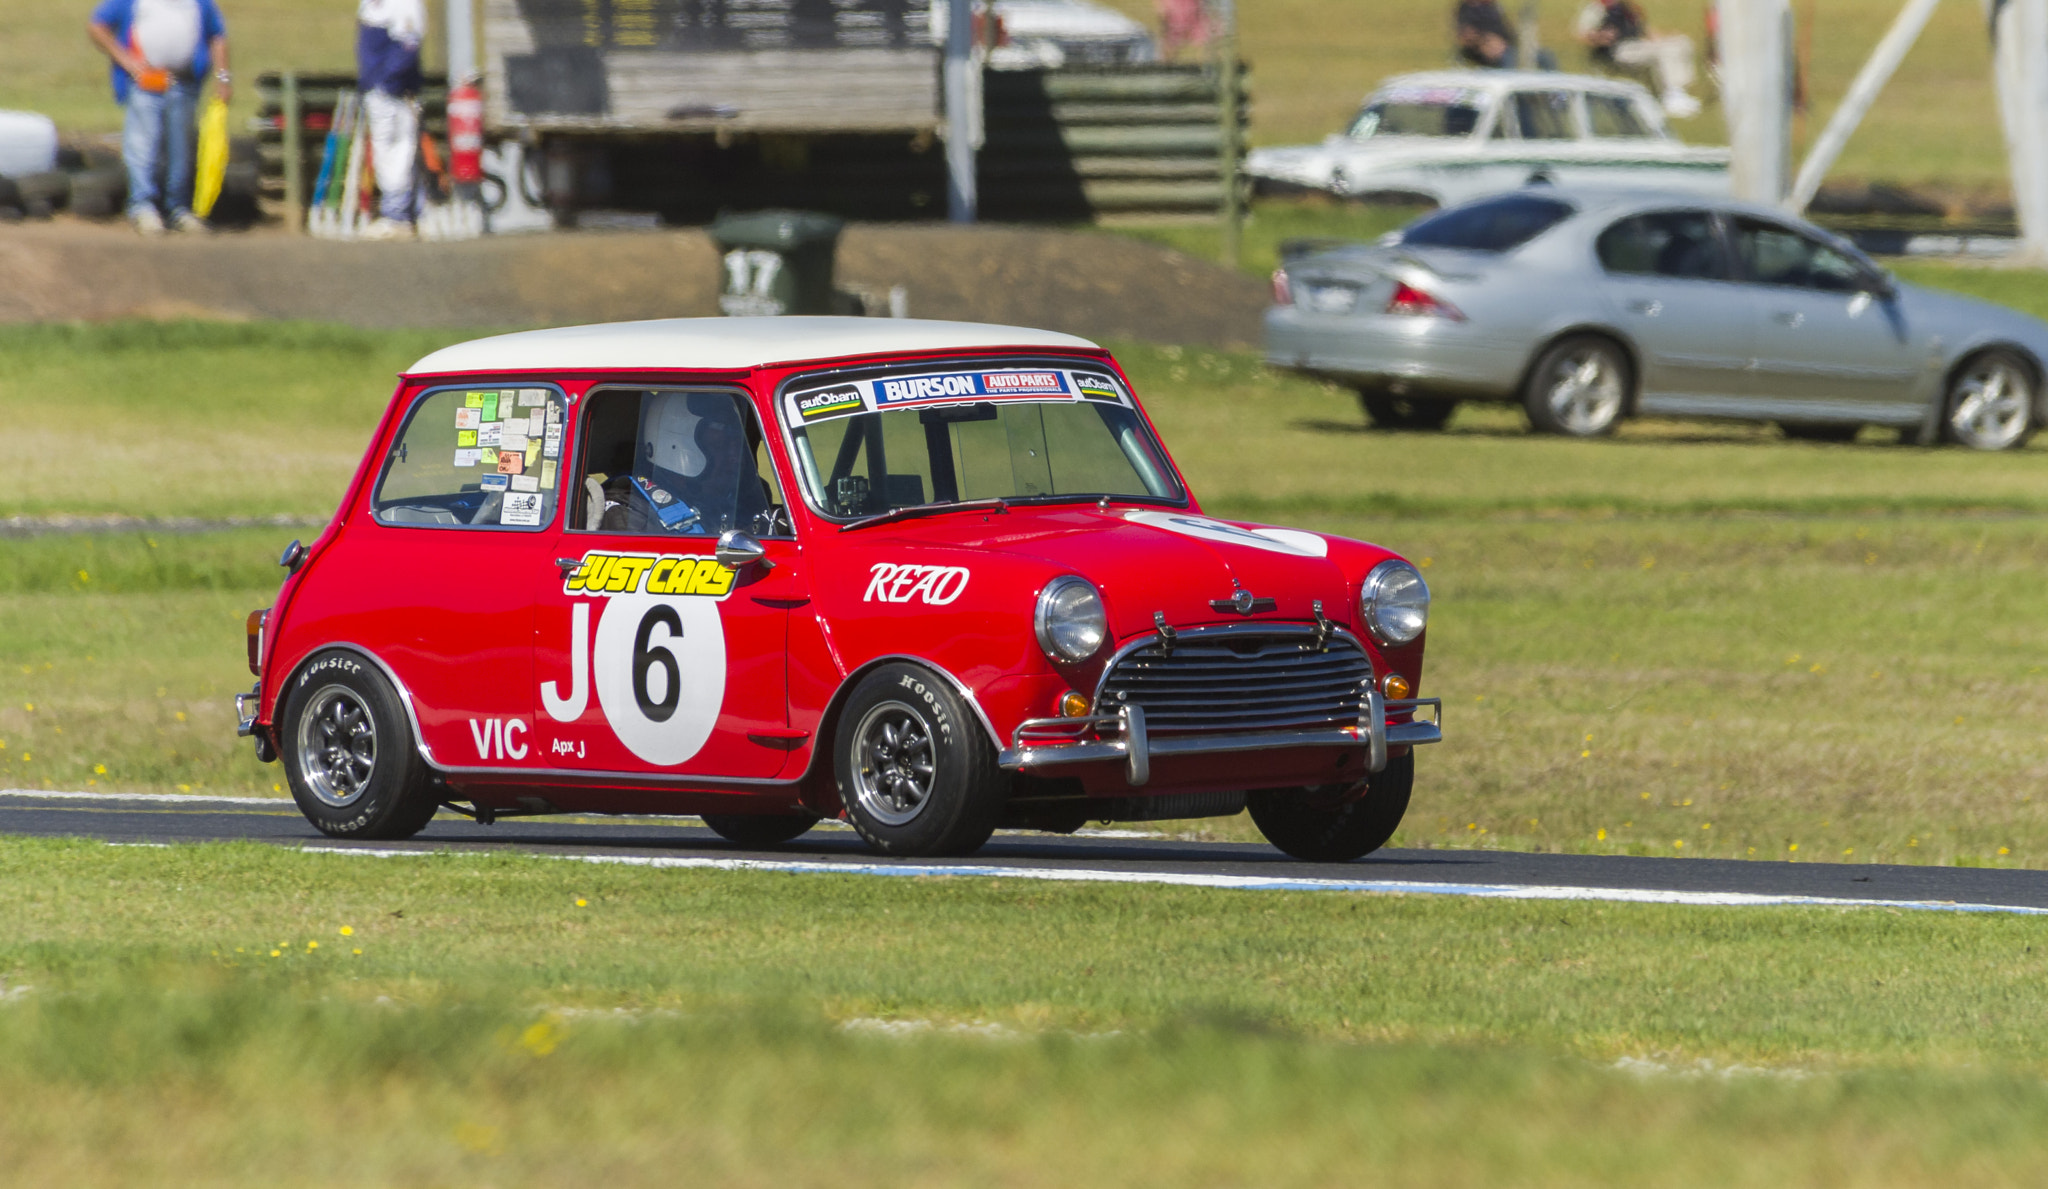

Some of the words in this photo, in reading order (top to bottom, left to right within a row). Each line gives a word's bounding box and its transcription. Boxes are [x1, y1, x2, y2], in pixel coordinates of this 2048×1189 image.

[883, 375, 976, 401] BURSON
[989, 375, 1020, 387] AUTO
[1020, 374, 1056, 386] PARTS
[567, 554, 656, 594] JUST
[646, 557, 738, 596] CARS
[863, 562, 970, 606] READ
[539, 602, 590, 723] J
[632, 603, 685, 723] 6
[469, 718, 529, 760] VIC
[551, 738, 575, 756] Apx
[577, 740, 585, 759] J
